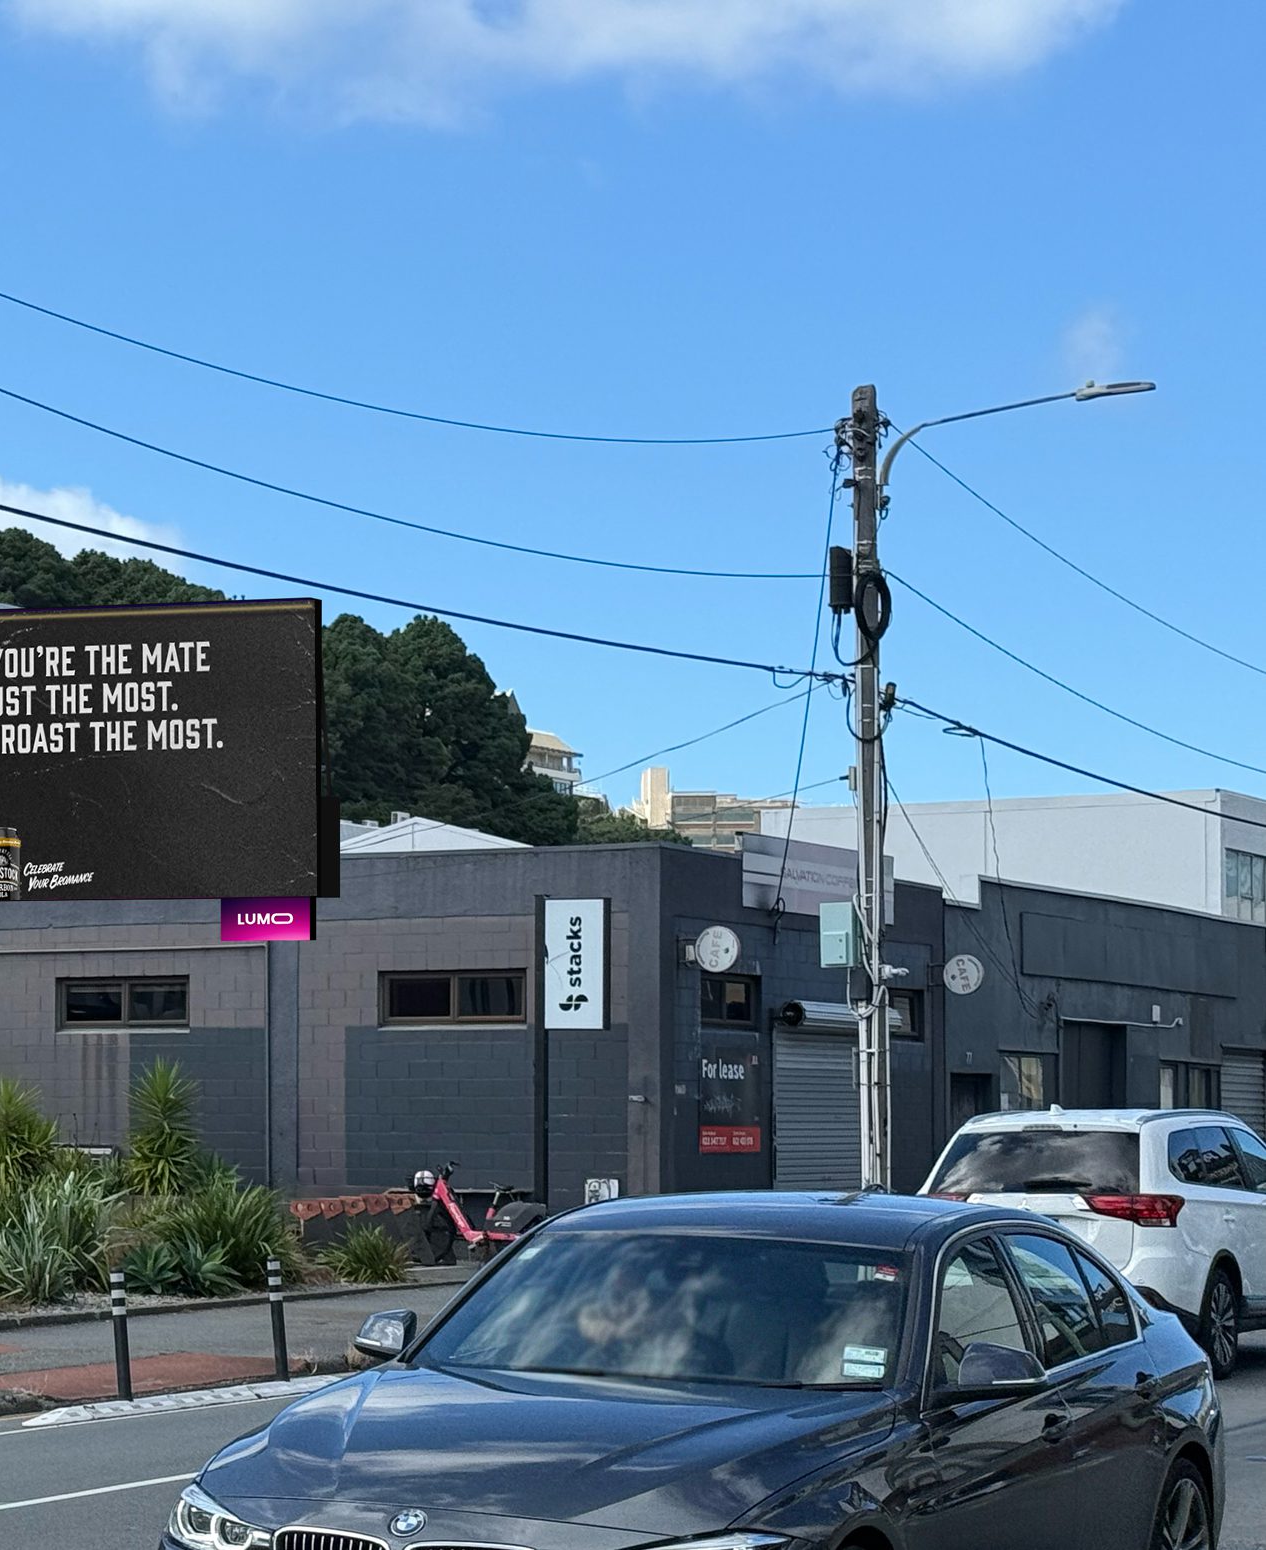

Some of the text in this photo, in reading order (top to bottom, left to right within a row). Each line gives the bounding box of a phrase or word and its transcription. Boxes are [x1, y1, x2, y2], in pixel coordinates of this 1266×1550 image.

[84, 643, 132, 676] THE
[142, 641, 211, 674] MATE
[45, 683, 93, 715] THE
[102, 681, 179, 713] MOST.
[1, 722, 81, 754] ROAST
[89, 720, 138, 752] THE
[146, 717, 224, 750] MOST.
[237, 912, 294, 925] LUMO
[565, 916, 582, 988] stacks
[709, 930, 722, 968] CAFE
[956, 958, 971, 992] CAFE
[701, 1059, 718, 1079] For
[719, 1058, 745, 1080] lease
